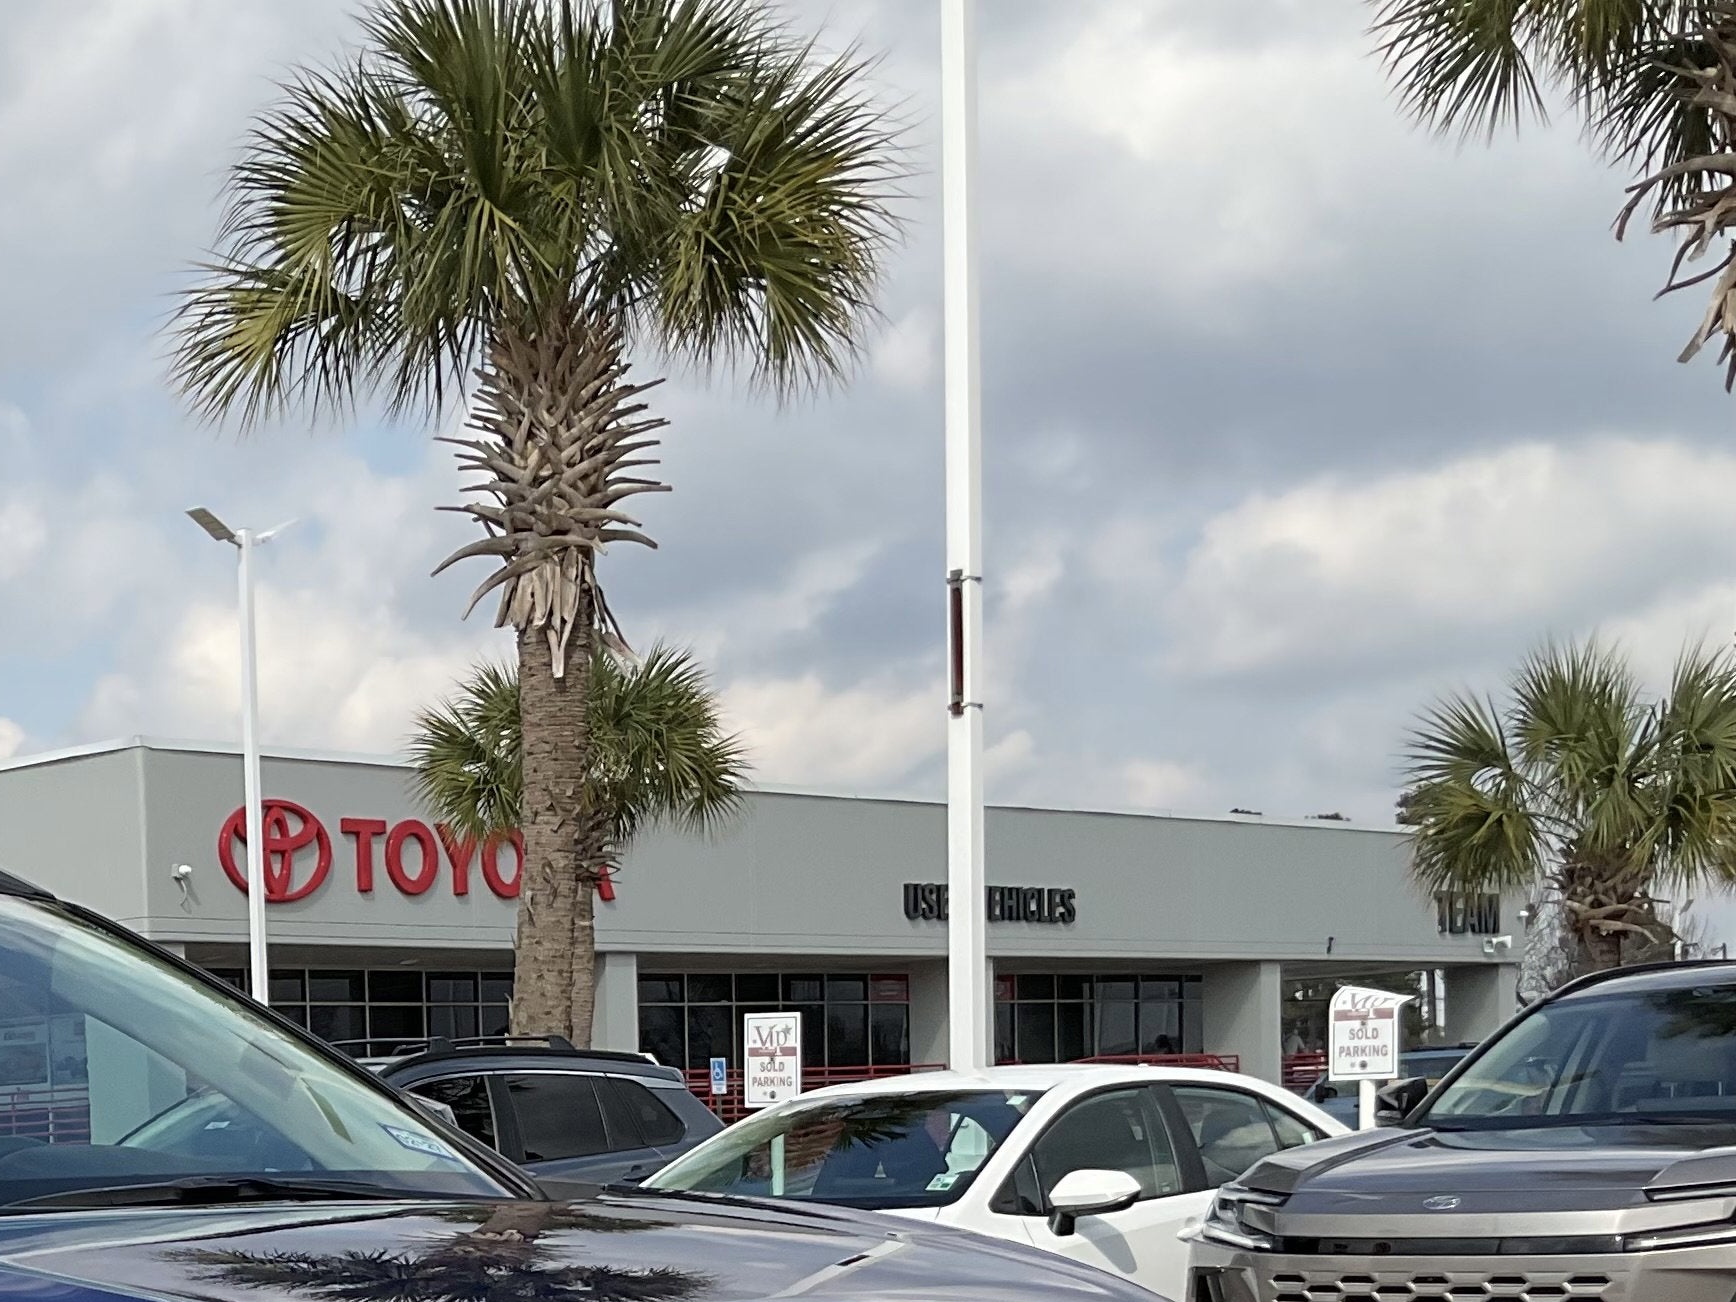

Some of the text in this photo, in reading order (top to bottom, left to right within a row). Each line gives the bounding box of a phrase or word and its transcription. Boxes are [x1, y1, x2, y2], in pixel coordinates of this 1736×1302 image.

[341, 818, 616, 901] TOYO
[903, 883, 1076, 923] USE EHICLES
[1433, 890, 1500, 934] TEAM
[1348, 1027, 1379, 1040] SOLD
[1338, 1044, 1389, 1058] PARKING
[759, 1061, 785, 1073] SOLD
[752, 1076, 793, 1088] PARKING
